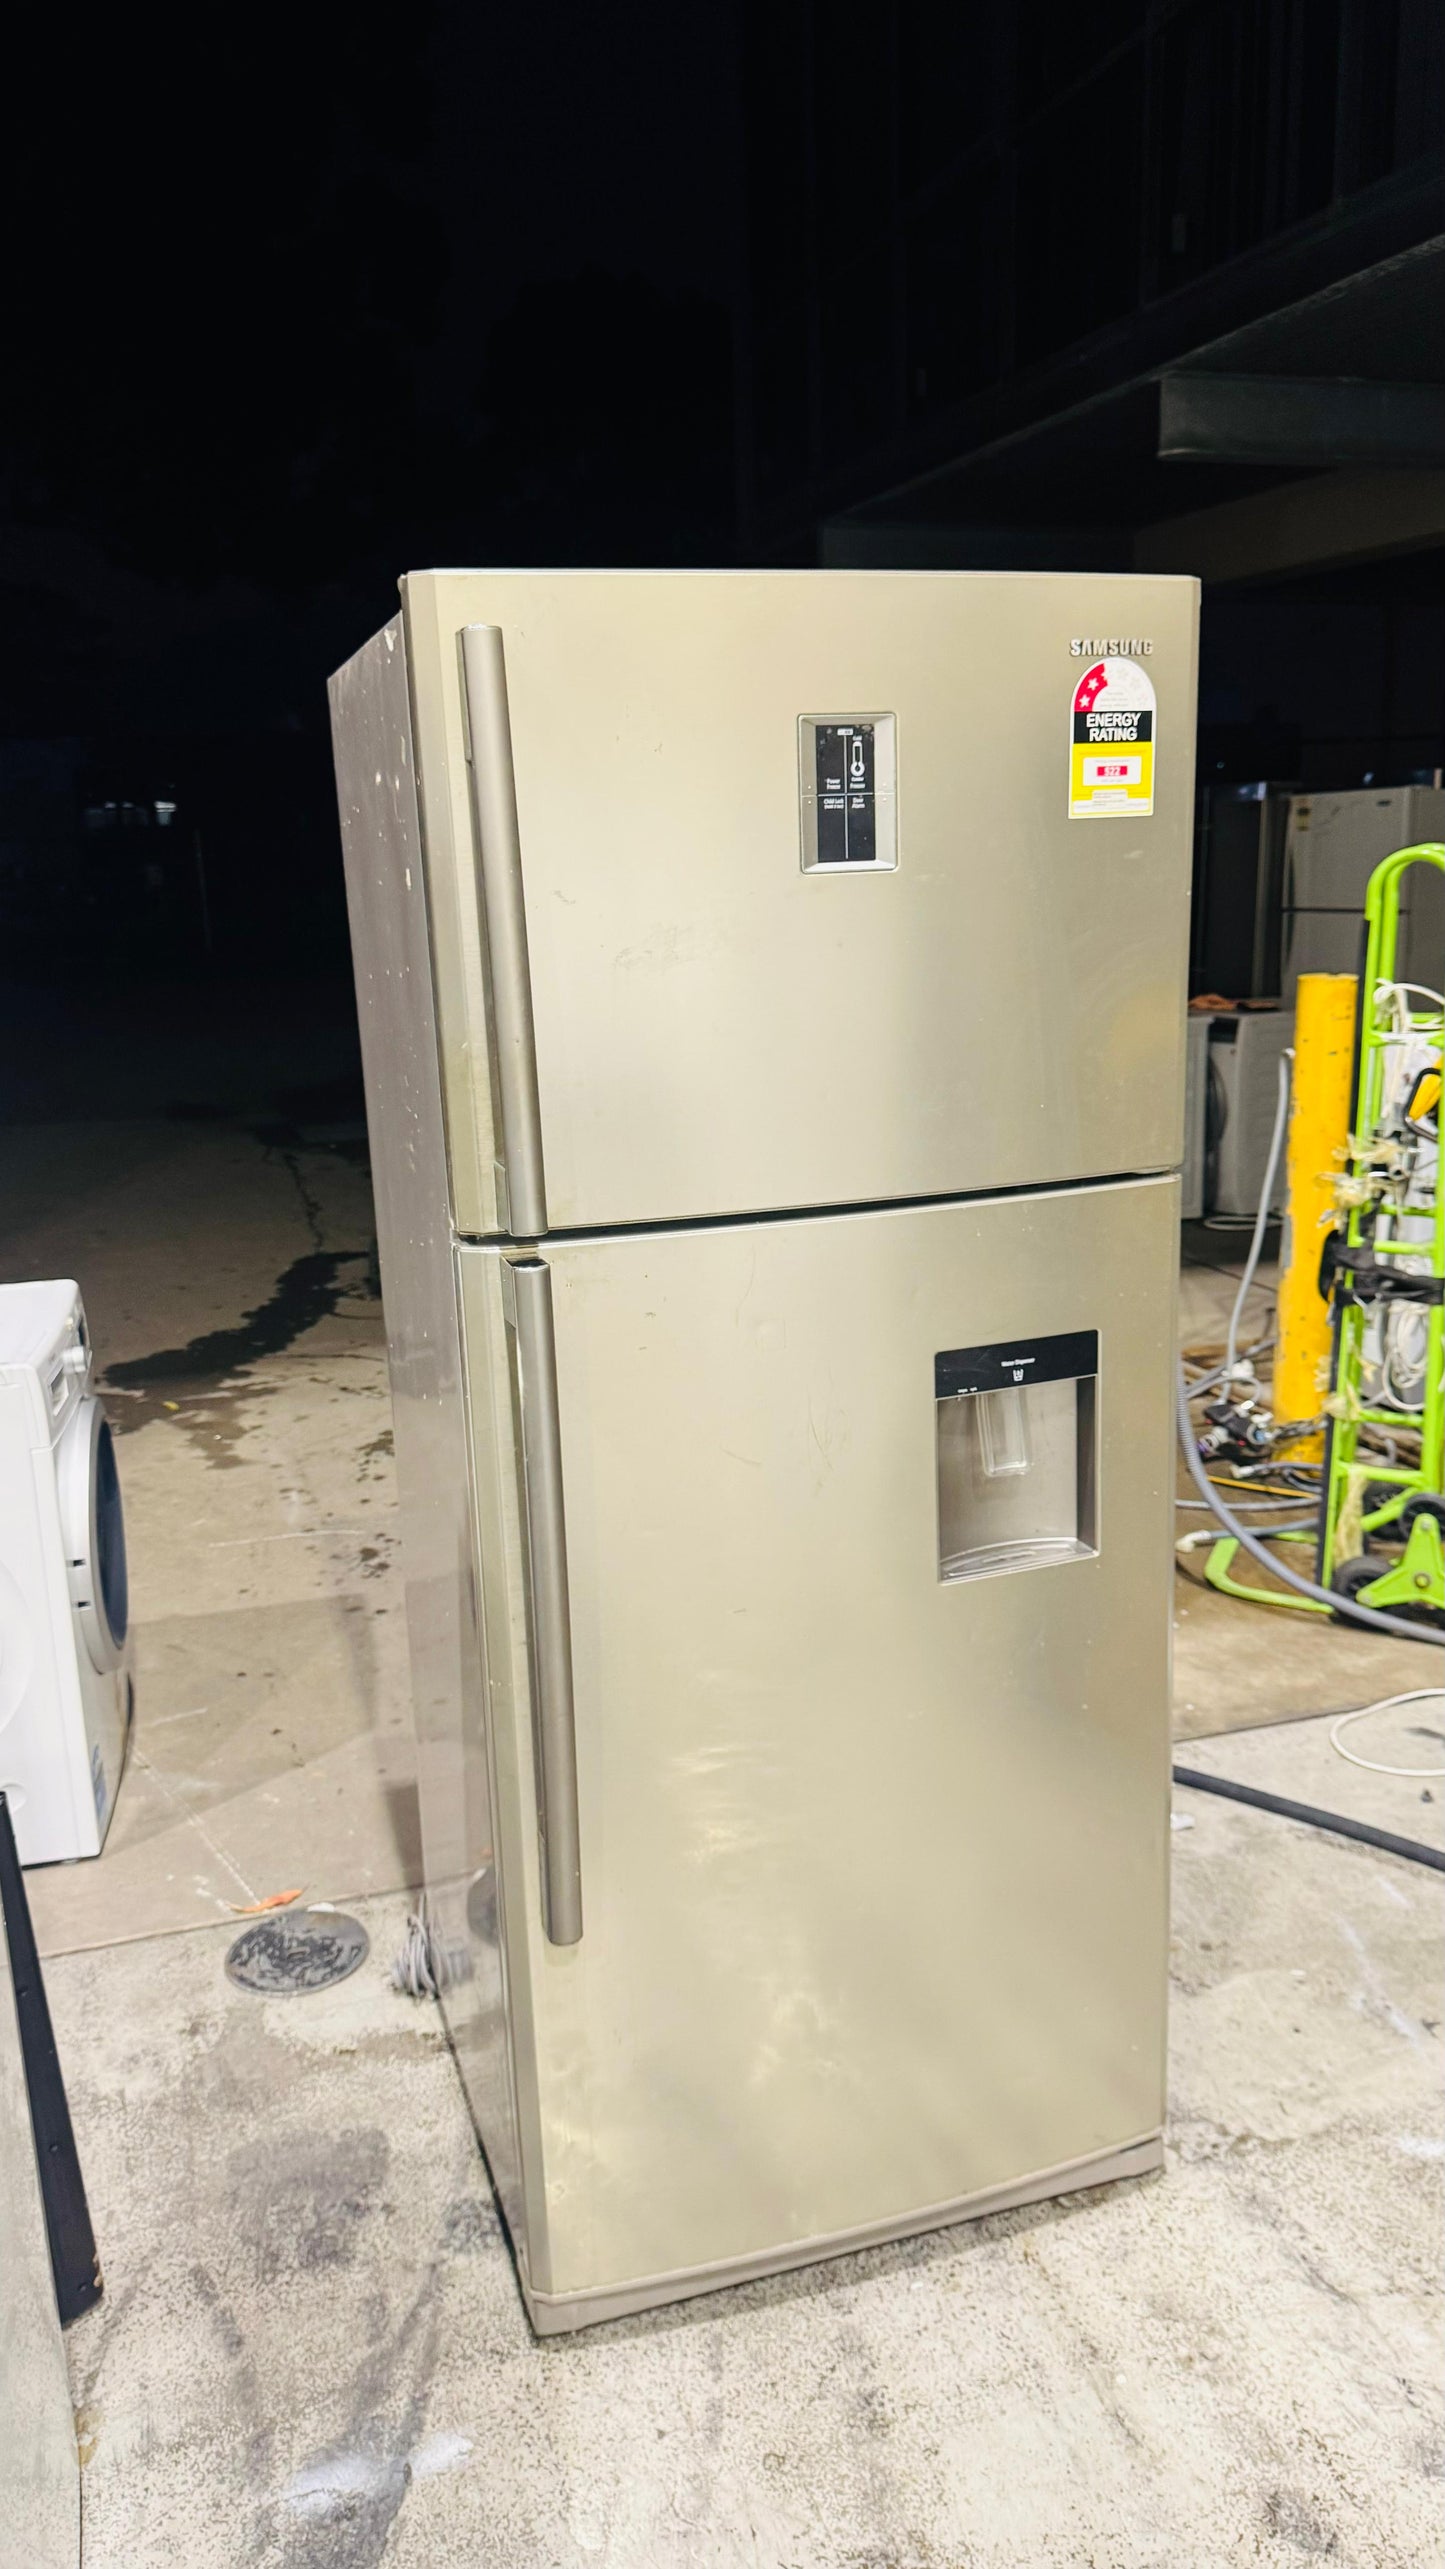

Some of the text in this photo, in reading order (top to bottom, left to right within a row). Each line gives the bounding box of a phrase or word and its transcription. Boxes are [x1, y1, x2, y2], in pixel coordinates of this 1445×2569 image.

[1070, 638, 1153, 656] SAMSUNG
[1086, 712, 1141, 728] ENERGY
[1089, 727, 1138, 742] RATING
